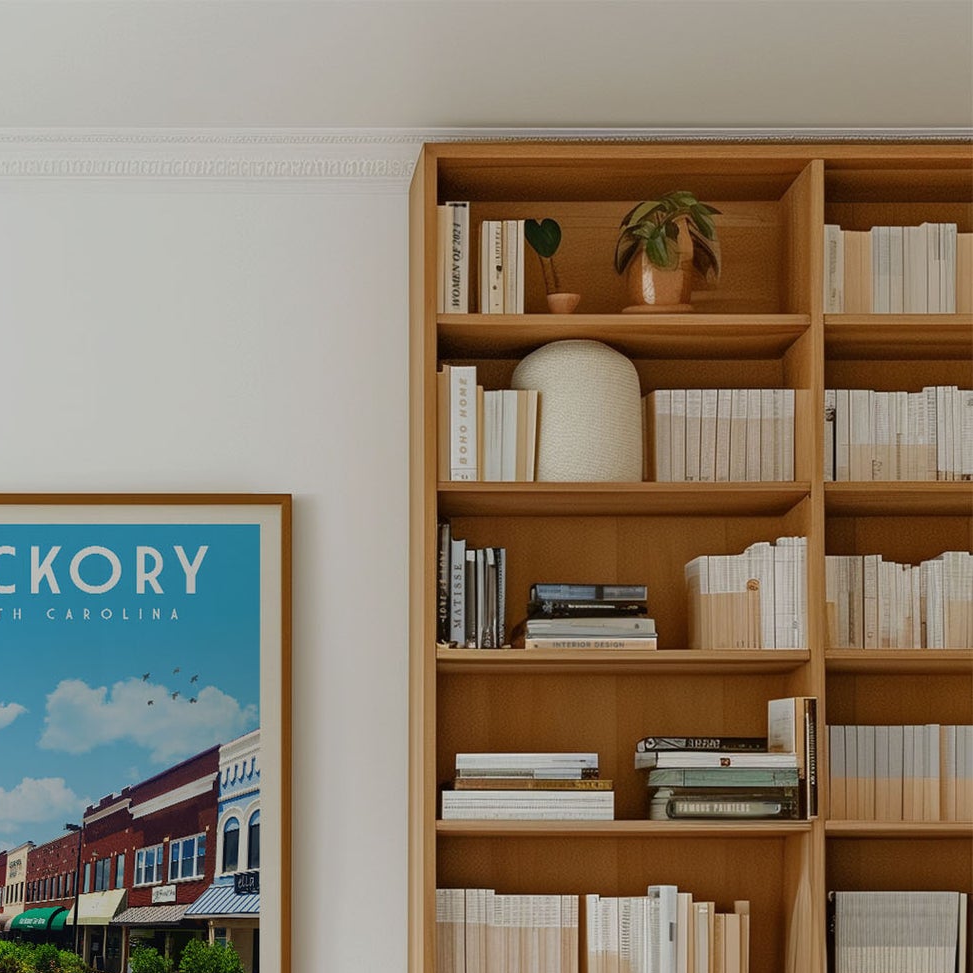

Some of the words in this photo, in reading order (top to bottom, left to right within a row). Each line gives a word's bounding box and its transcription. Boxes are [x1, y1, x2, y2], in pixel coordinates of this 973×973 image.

[451, 246, 461, 262] OF
[451, 265, 461, 308] WOMEN
[459, 378, 468, 418] HOME
[459, 425, 468, 465] BOHO
[46, 608, 179, 621] CAROLINA
[453, 563, 463, 629] MATISSE
[678, 803, 711, 813] FAMOUS
[713, 803, 750, 813] PAINTERS
